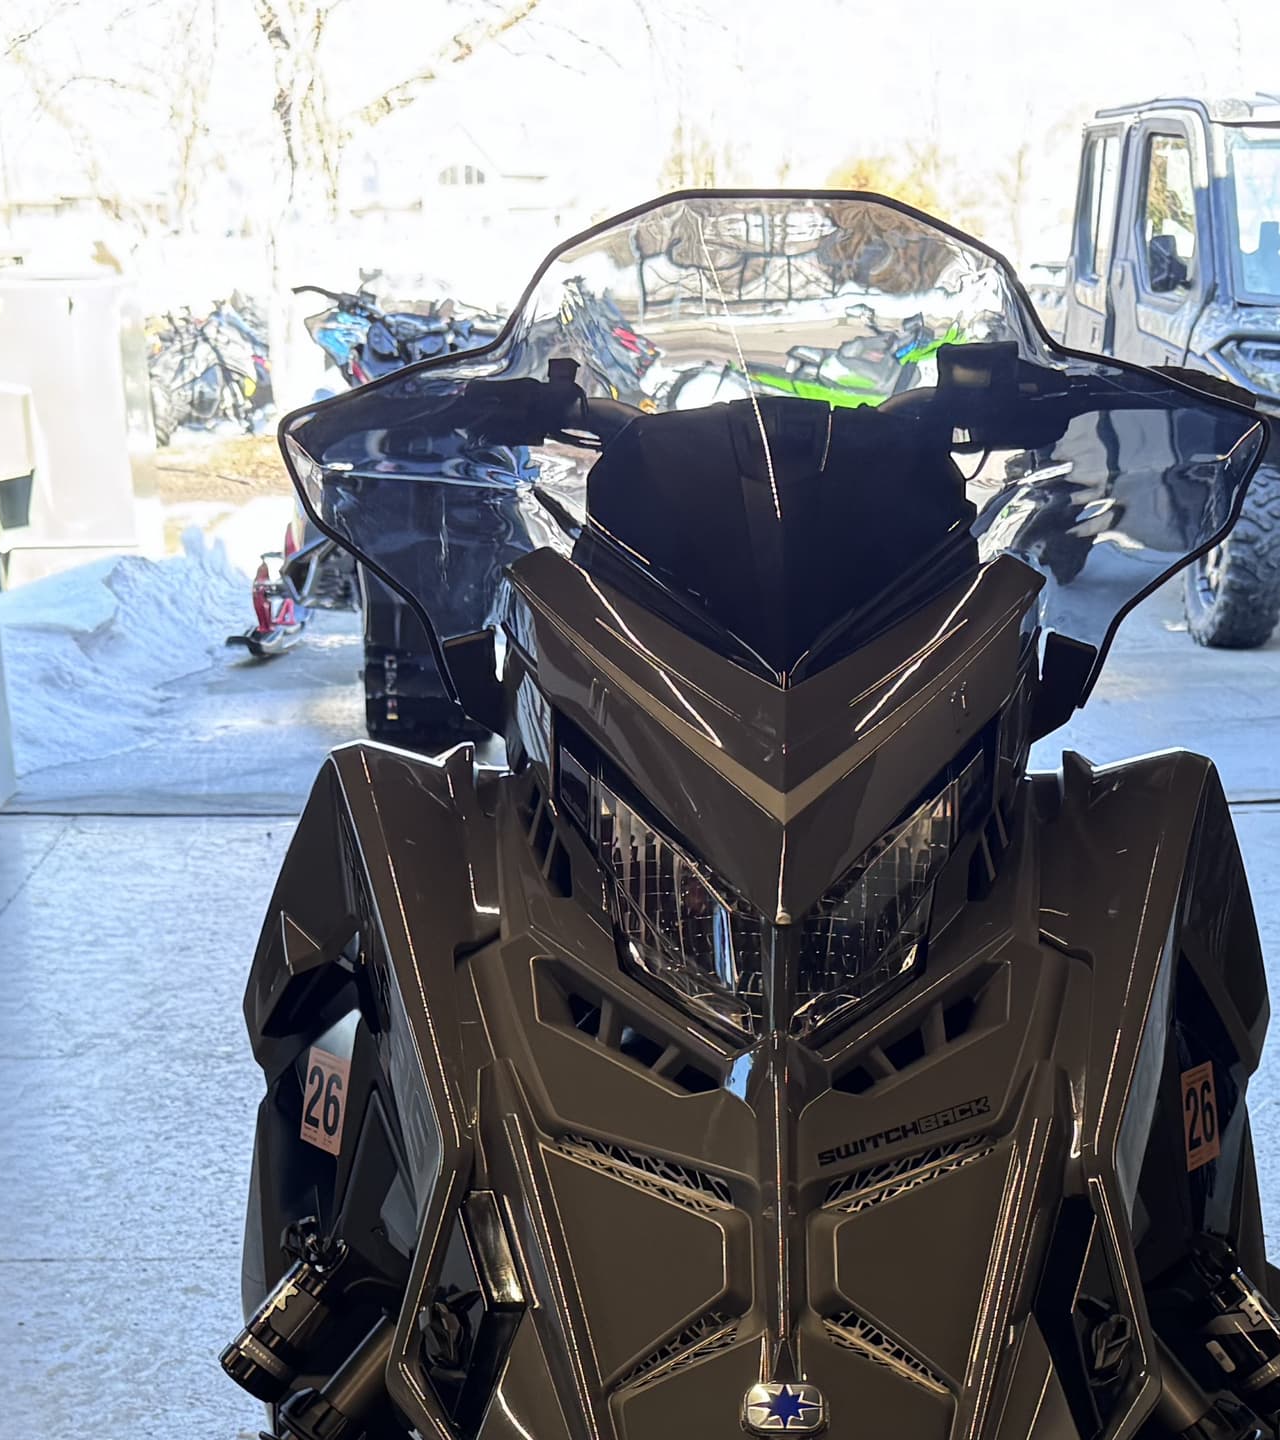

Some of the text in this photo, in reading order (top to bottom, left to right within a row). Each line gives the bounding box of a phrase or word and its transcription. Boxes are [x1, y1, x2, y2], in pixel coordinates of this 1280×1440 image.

[304, 1065, 343, 1137] 26
[817, 1096, 991, 1167] SWITCHBACK
[1185, 1080, 1215, 1151] 26
